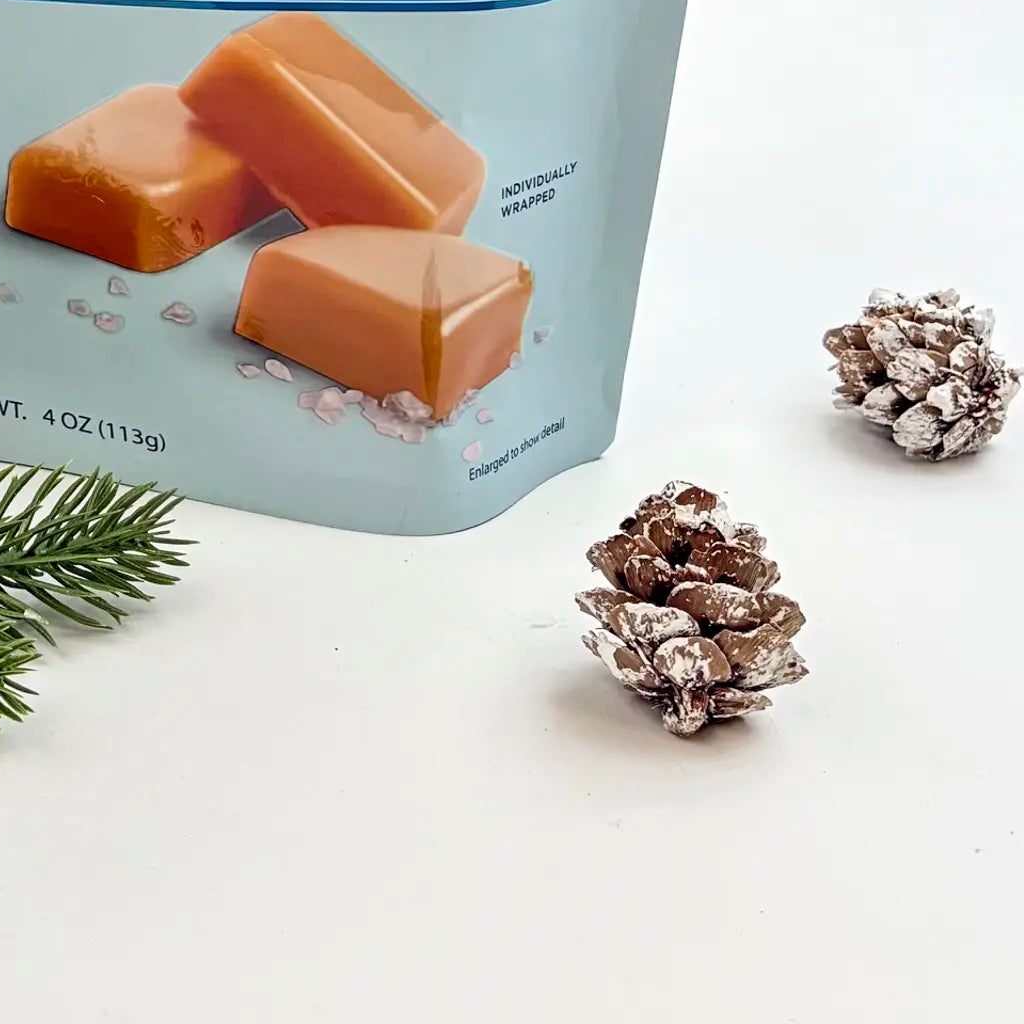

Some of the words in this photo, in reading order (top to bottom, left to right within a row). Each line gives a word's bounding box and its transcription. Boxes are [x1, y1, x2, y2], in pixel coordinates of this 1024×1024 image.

[501, 161, 578, 200] INDIVIDUALLY
[501, 188, 556, 218] WRAPPED
[42, 409, 56, 426] 4
[61, 412, 93, 434] OZ
[98, 420, 167, 452] (113g)
[469, 450, 510, 481] Enlarged
[510, 447, 519, 459] to
[520, 434, 540, 454] show
[540, 416, 565, 439] detail
